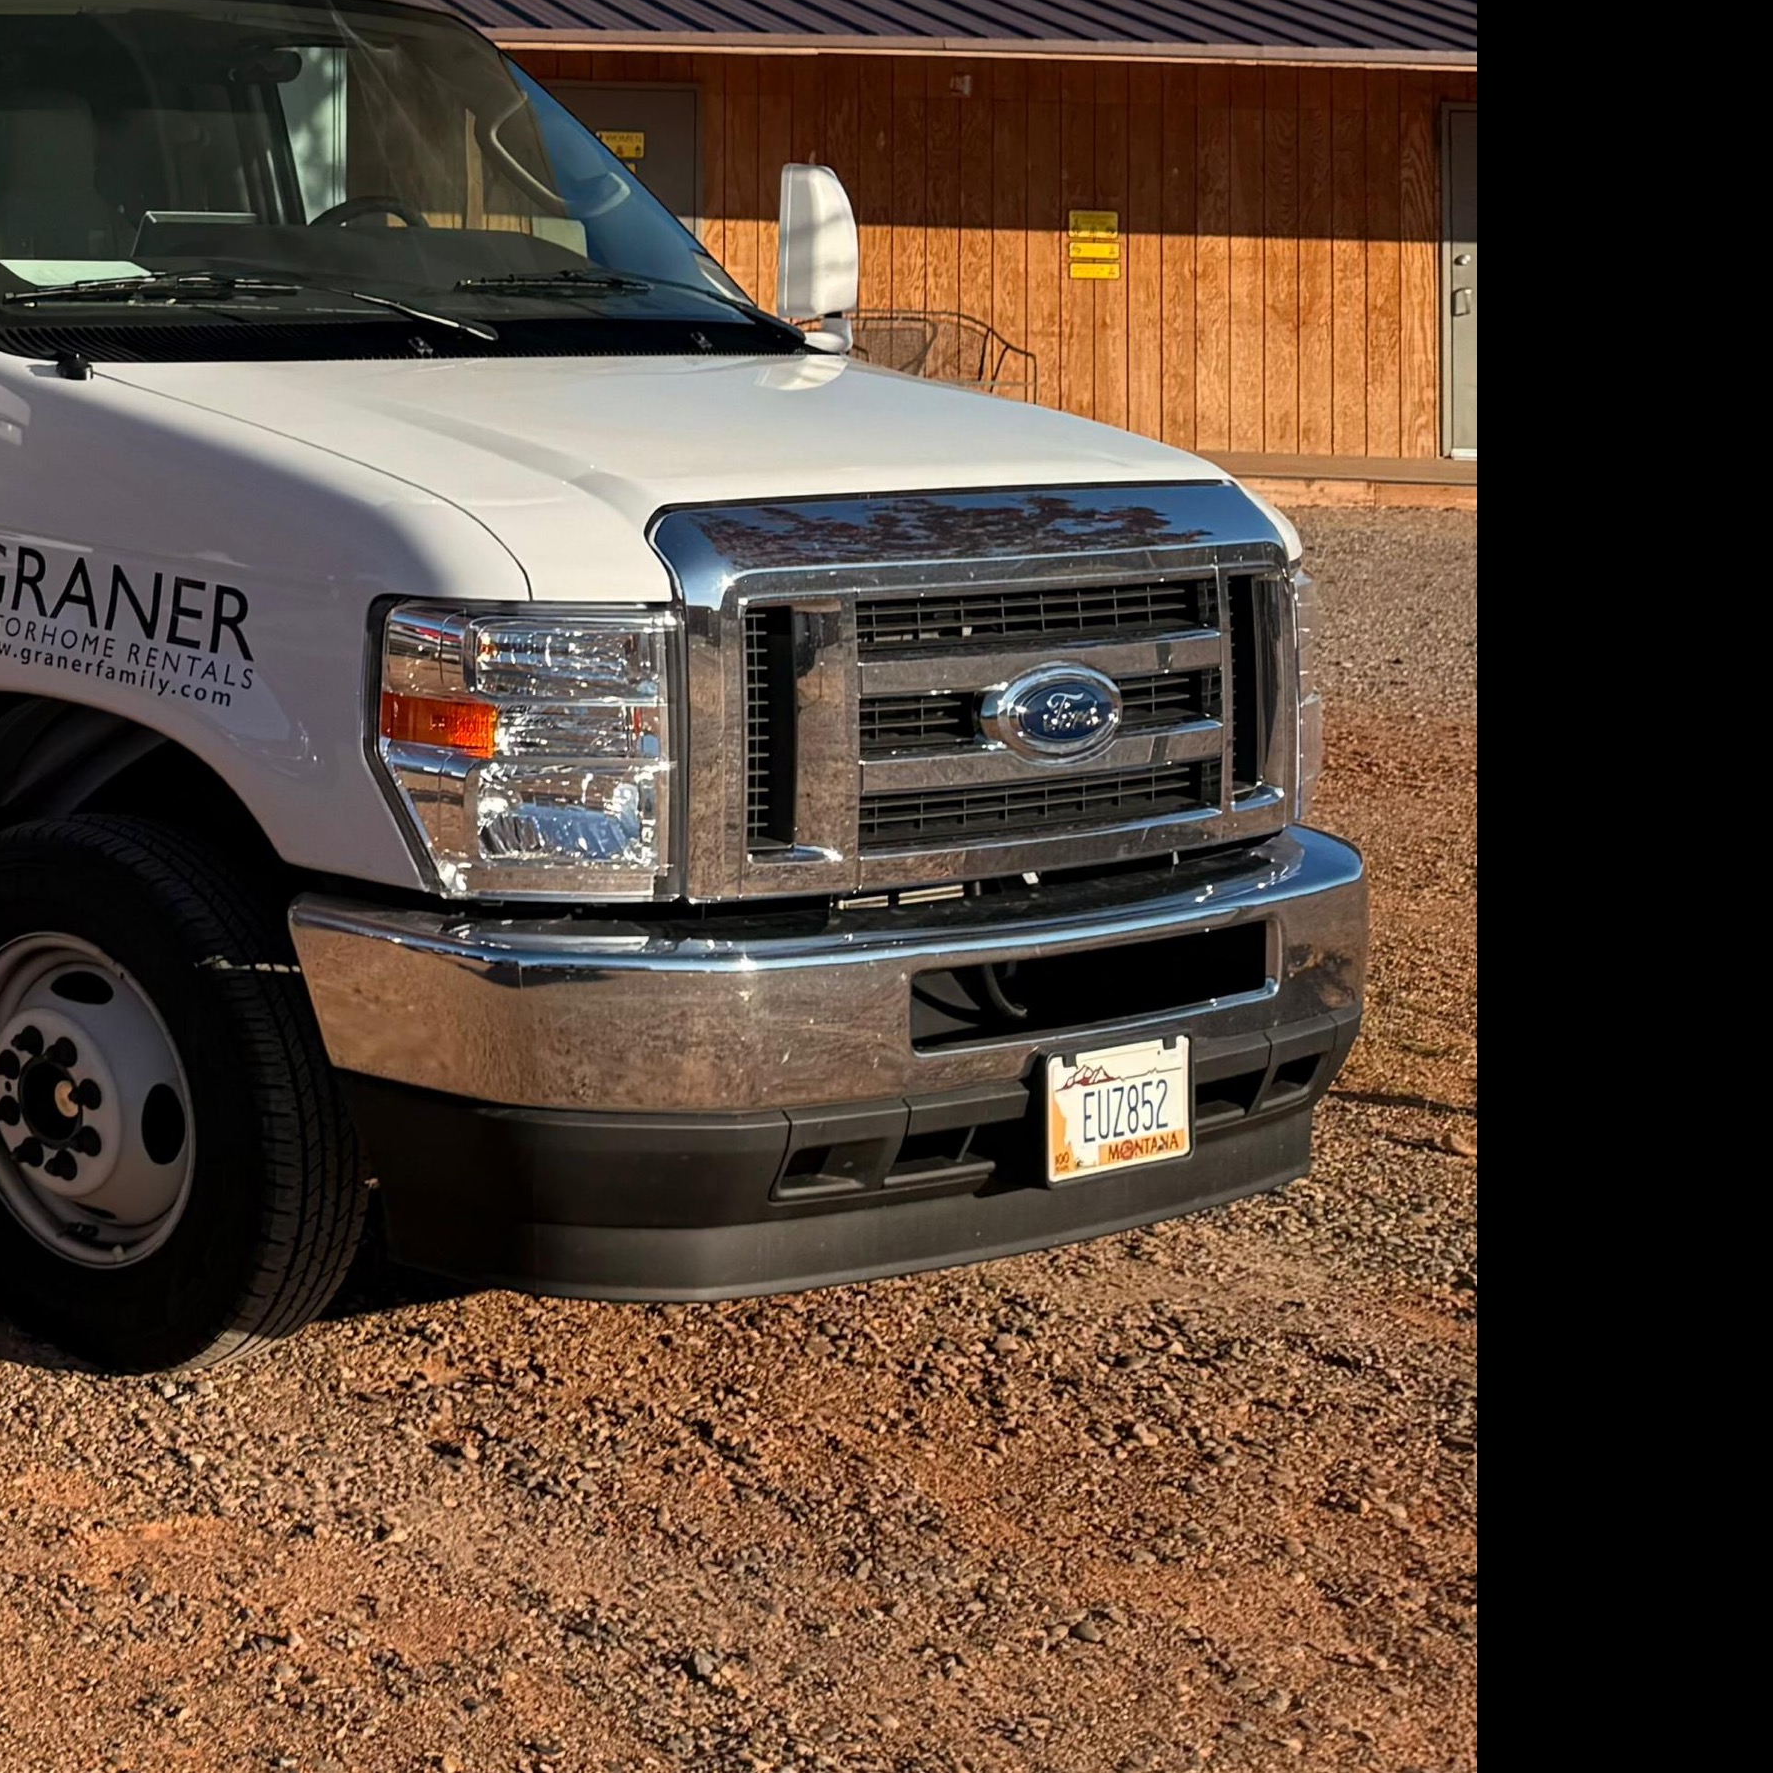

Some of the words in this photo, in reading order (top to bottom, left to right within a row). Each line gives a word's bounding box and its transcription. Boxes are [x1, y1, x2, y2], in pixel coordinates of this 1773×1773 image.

[126, 642, 255, 691] RENTALS
[1083, 1078, 1169, 1144] EUZ852
[1107, 1131, 1179, 1162] MONTANA
